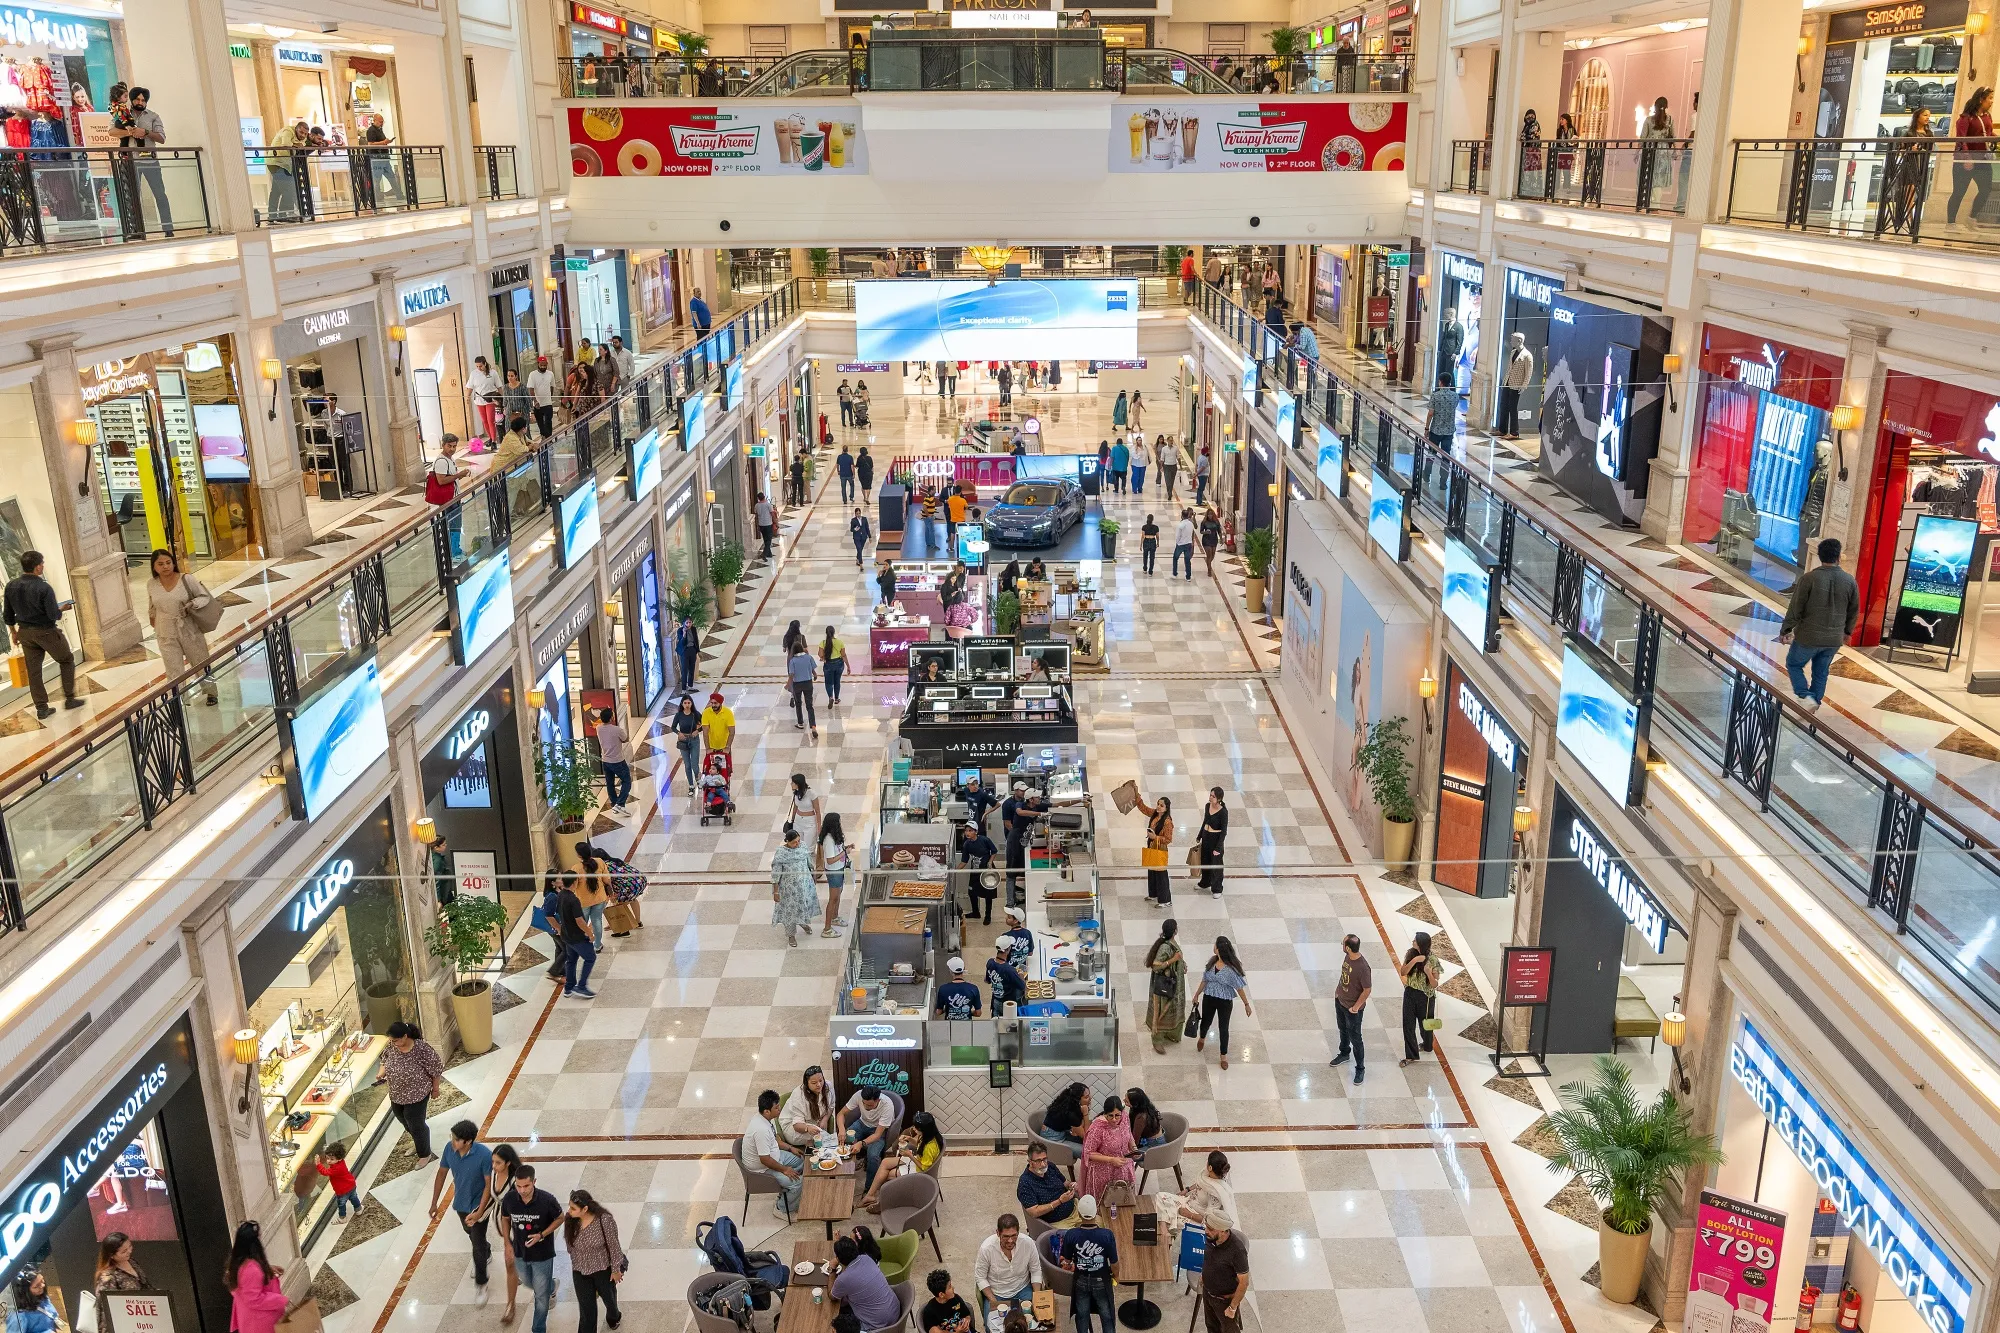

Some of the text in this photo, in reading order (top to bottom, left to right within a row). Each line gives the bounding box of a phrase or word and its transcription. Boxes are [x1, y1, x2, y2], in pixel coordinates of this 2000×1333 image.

[1866, 4, 1925, 27] Samsonite
[680, 134, 755, 150] Krispy Kreme
[1224, 130, 1300, 147] Krispy Kreme
[664, 165, 684, 173] NOW
[686, 165, 709, 173] OPEN
[491, 263, 530, 288] MADISON
[403, 284, 451, 315] NAUTICA
[303, 308, 350, 336] CALVIN KLEIN
[960, 317, 1005, 325] Exceptional
[1554, 307, 1575, 325] GEOX
[1740, 360, 1772, 392] PUMA
[539, 628, 567, 666] CHARLES
[450, 710, 490, 760] ALDO
[1459, 682, 1515, 773] STEVE MADDEN
[946, 743, 1024, 751] ANASTASIA
[1443, 779, 1482, 797] STEVE MADDEN
[293, 859, 354, 932] ALDO
[1570, 819, 1663, 954] STEVE MADDEN
[948, 993, 970, 1008] Life
[858, 1058, 900, 1076] Love
[62, 1062, 167, 1195] Accessories
[1731, 1041, 1952, 1333] Bath & Body Works
[1728, 1215, 1754, 1231] ALL
[1731, 1204, 1741, 1213] TO
[1741, 1206, 1769, 1221] BELIEVE
[1707, 1219, 1774, 1246] BODY LOTION
[1076, 1239, 1105, 1259] Life
[1700, 1226, 1776, 1270] ₹799
[126, 1304, 159, 1316] SALE
[137, 1322, 154, 1330] Upto
